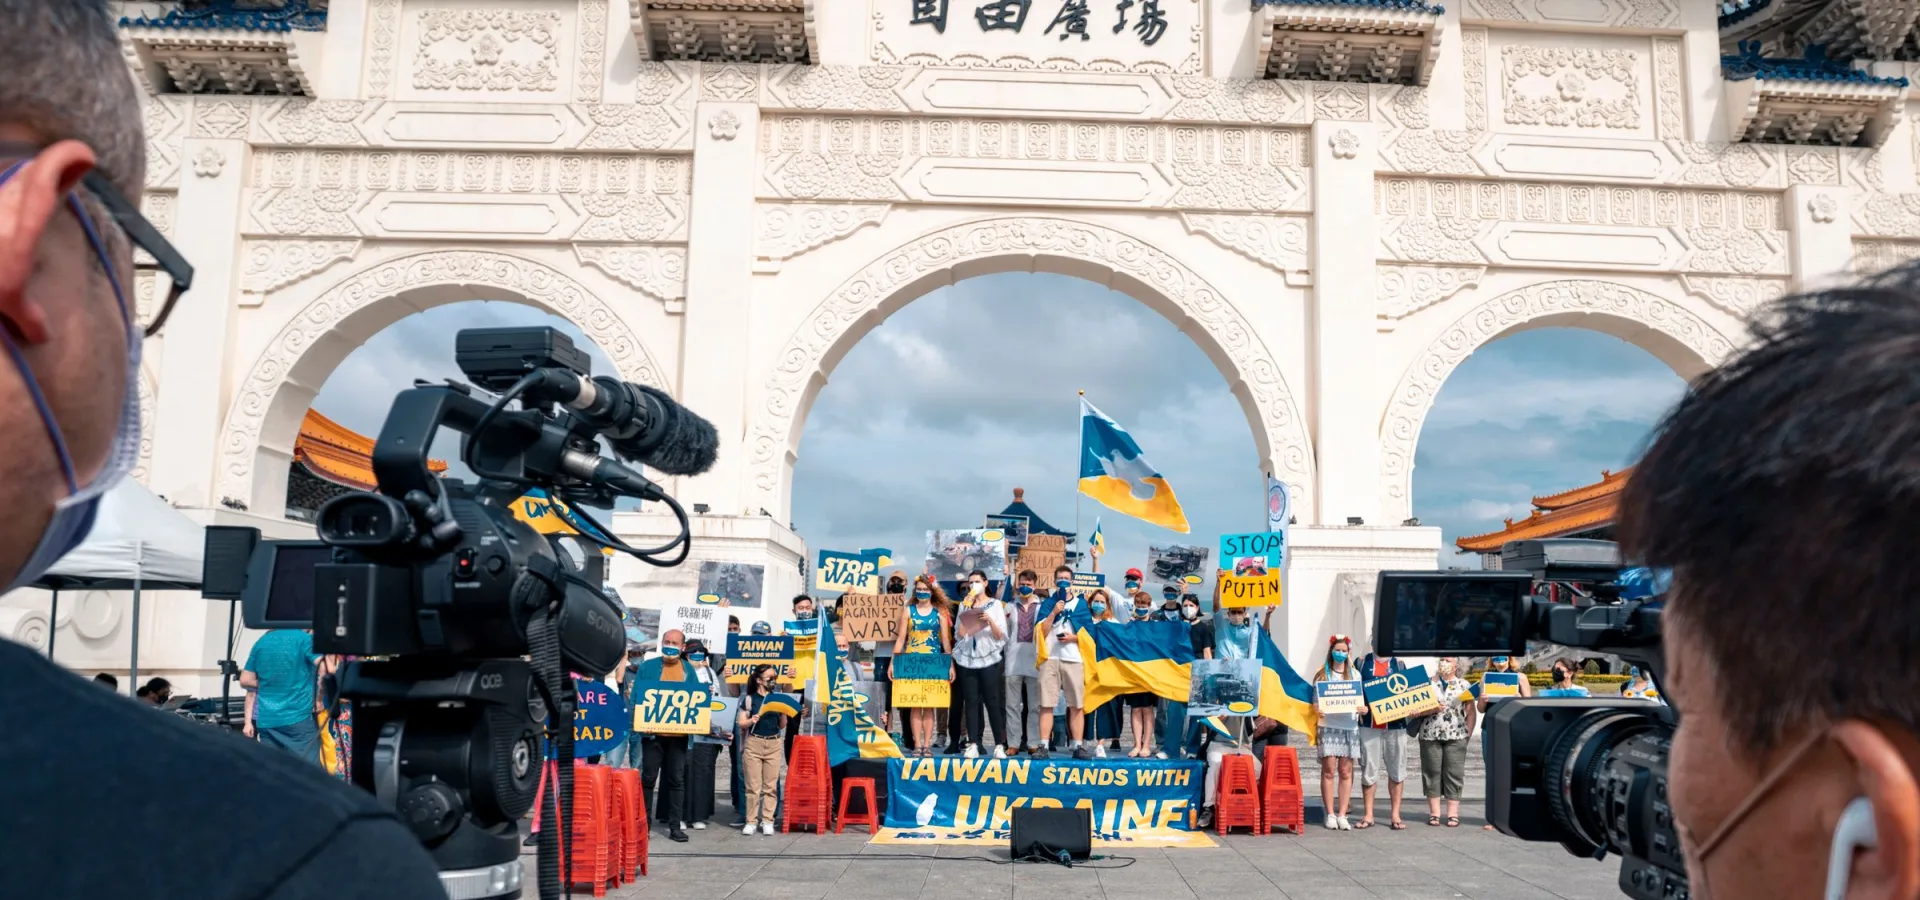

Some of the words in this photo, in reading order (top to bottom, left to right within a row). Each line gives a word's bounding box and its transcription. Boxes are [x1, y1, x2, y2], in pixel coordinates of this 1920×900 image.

[1224, 535, 1280, 556] STOP
[824, 557, 875, 575] STOP
[825, 570, 868, 587] WAR
[844, 595, 905, 606] RUSSIANS
[677, 606, 713, 620] 俄羅斯
[844, 607, 897, 618] AGAINST
[587, 609, 618, 639] SONY
[849, 622, 899, 639] WAR
[737, 641, 784, 651] TAIWAN
[732, 664, 790, 676] UKRNE
[643, 688, 706, 711] STOP
[1376, 691, 1431, 714] TAIWAN
[643, 705, 700, 725] WAR
[900, 758, 1031, 784] TAIWAN
[1041, 767, 1128, 786] STANDS
[1136, 769, 1191, 787] WITH
[954, 795, 1189, 830] UKINE
